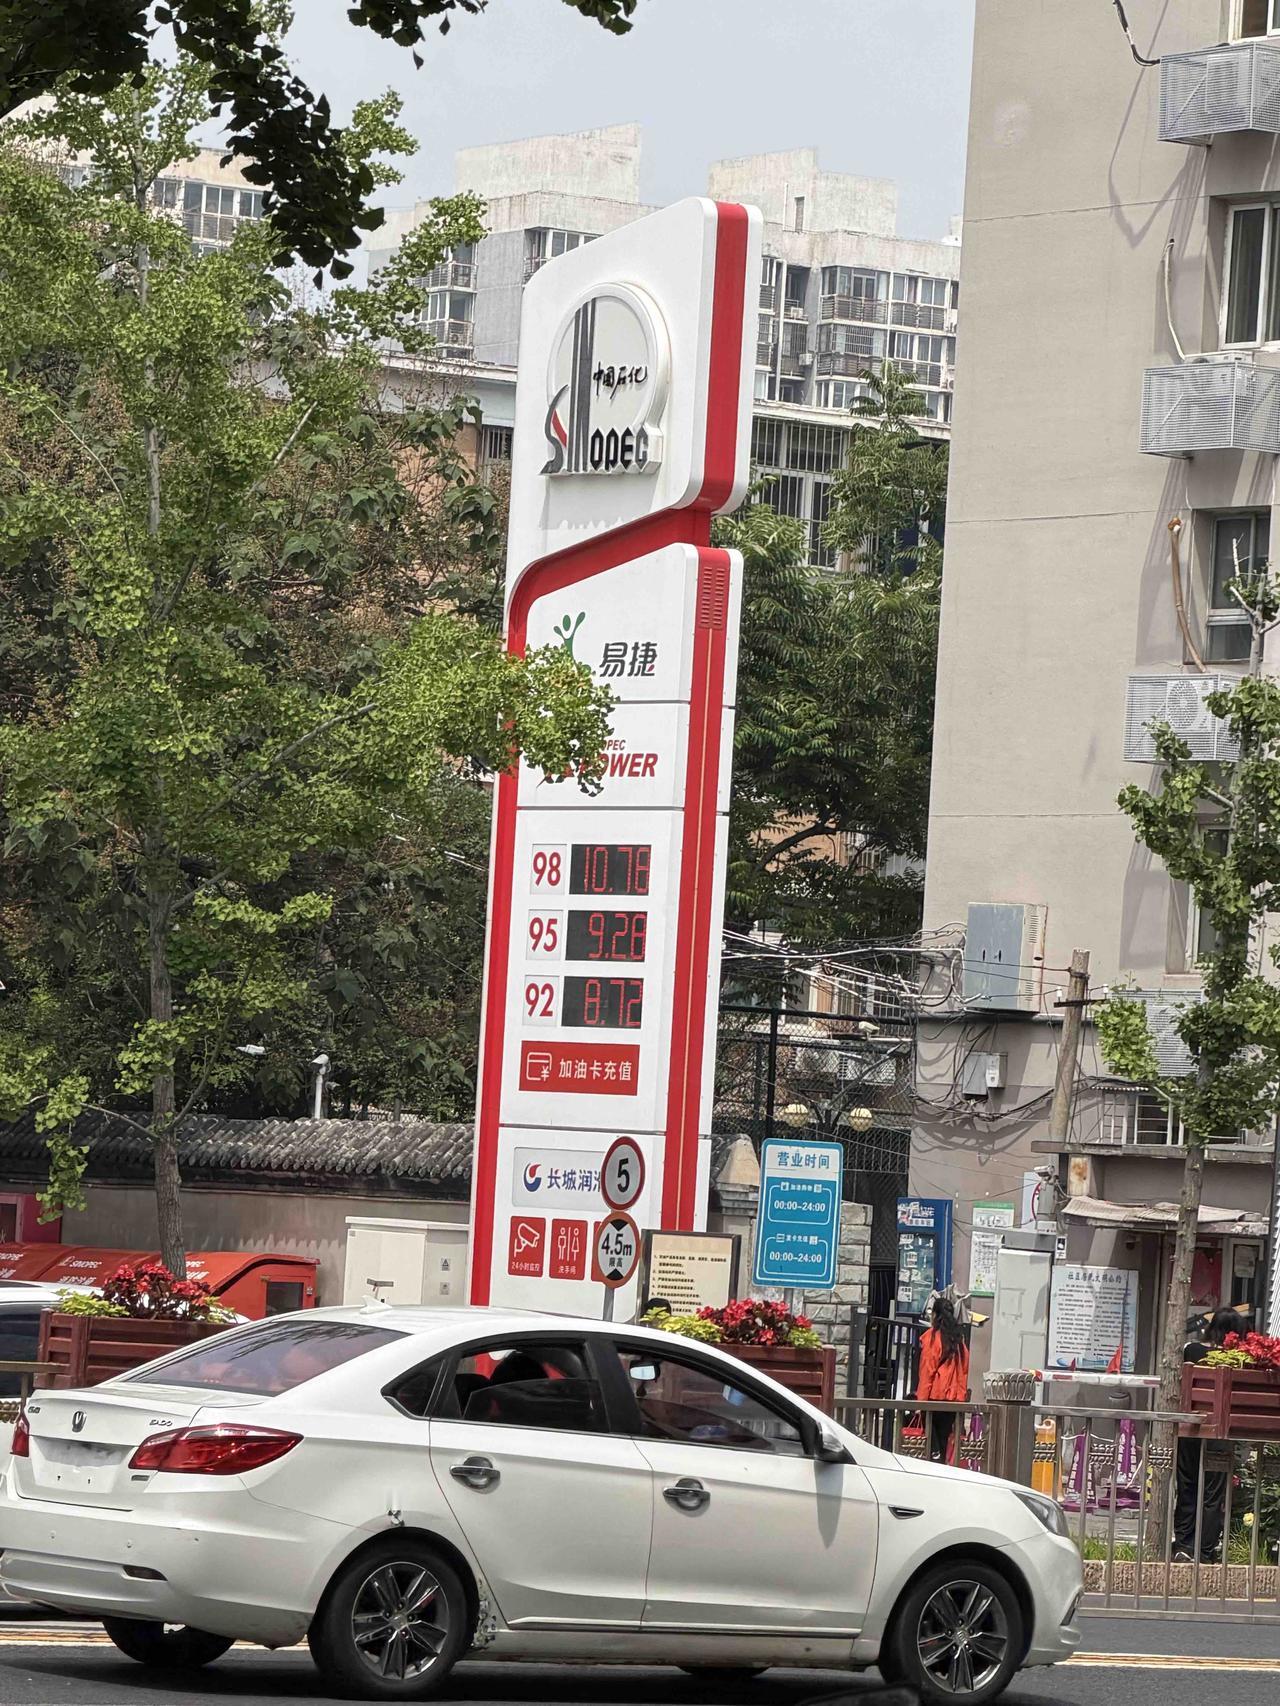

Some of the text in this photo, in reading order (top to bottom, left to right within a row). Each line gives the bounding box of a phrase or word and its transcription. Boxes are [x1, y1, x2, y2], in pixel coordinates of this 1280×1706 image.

[593, 362, 648, 399] 中国石化
[600, 642, 658, 677] 易捷
[588, 753, 659, 777] OWER
[533, 847, 651, 893] 98 10.78
[529, 913, 647, 960] 95 9.28
[525, 979, 643, 1026] 92 8.72
[558, 1058, 633, 1081] 加油卡充值
[617, 1158, 630, 1193] 5
[777, 1151, 830, 1169] 营业时间
[601, 1232, 632, 1257] 4.5m
[608, 1257, 623, 1268] 限高
